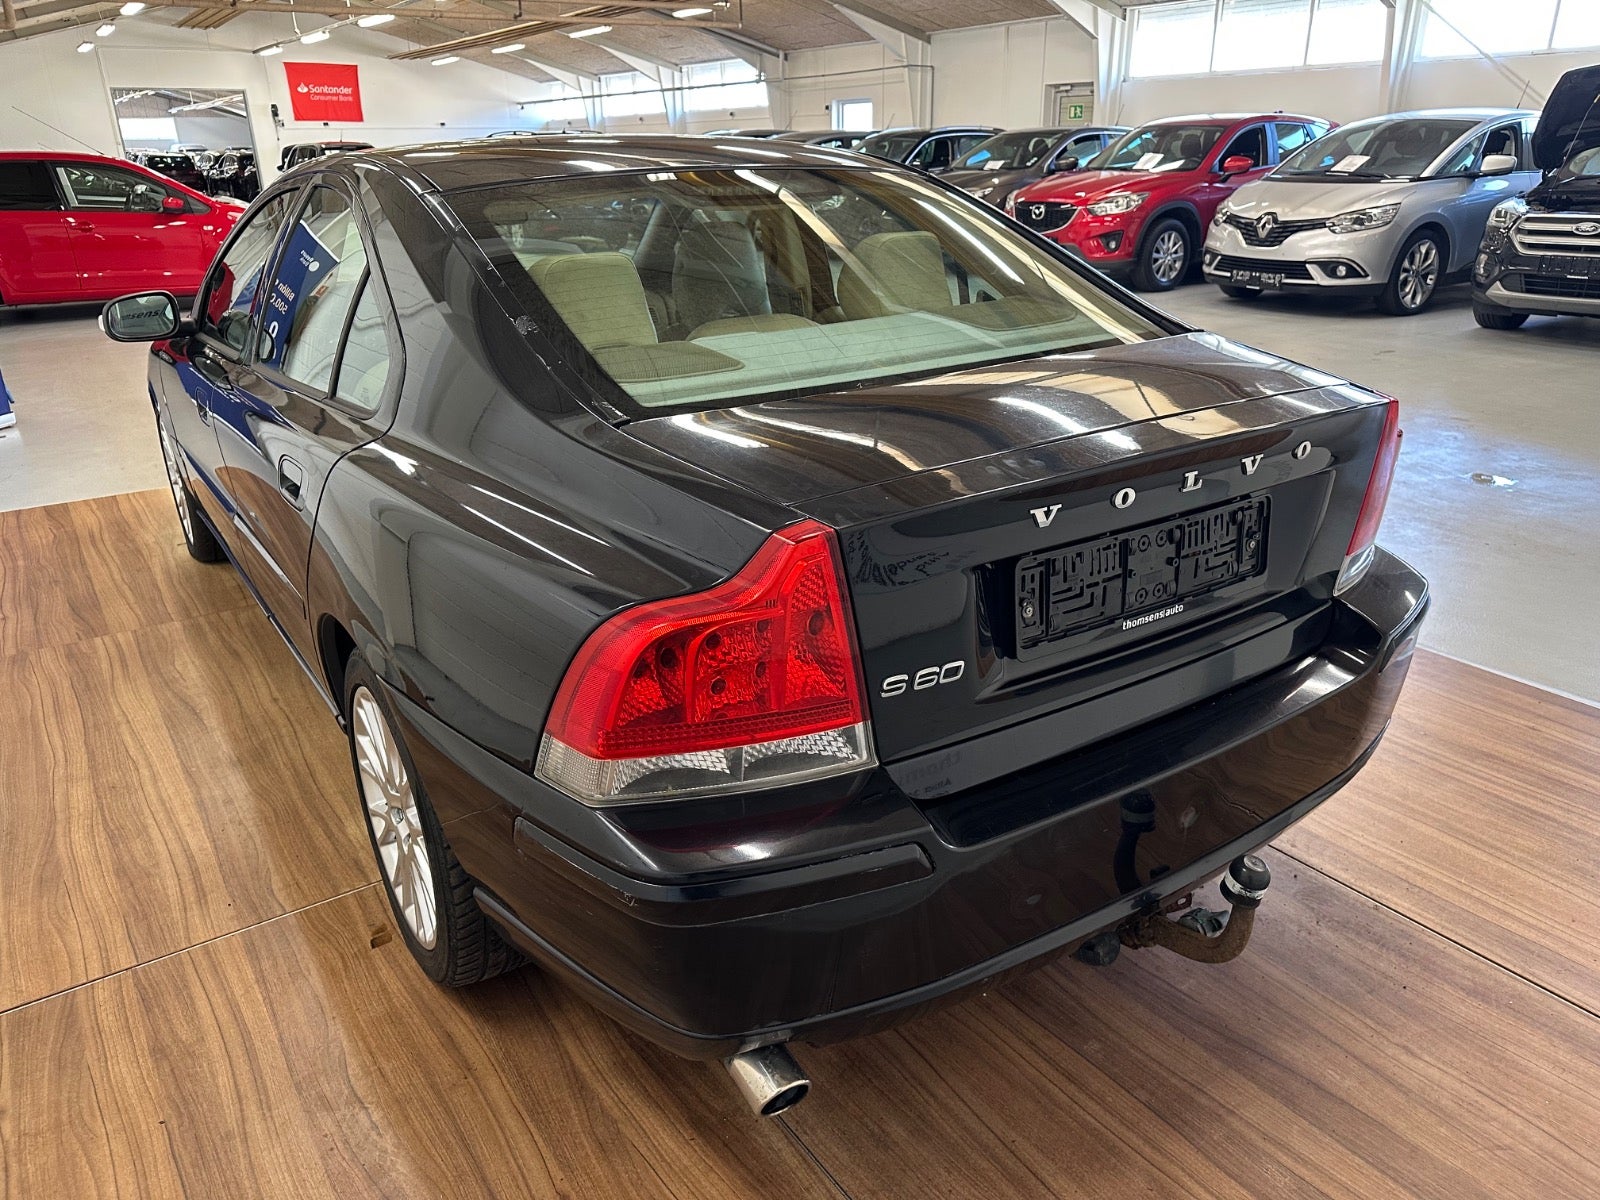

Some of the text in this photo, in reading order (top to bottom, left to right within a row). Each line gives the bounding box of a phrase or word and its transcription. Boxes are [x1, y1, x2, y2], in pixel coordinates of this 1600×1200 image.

[309, 84, 352, 94] Santander
[339, 94, 353, 102] Bank
[1030, 441, 1312, 528] VOLVO
